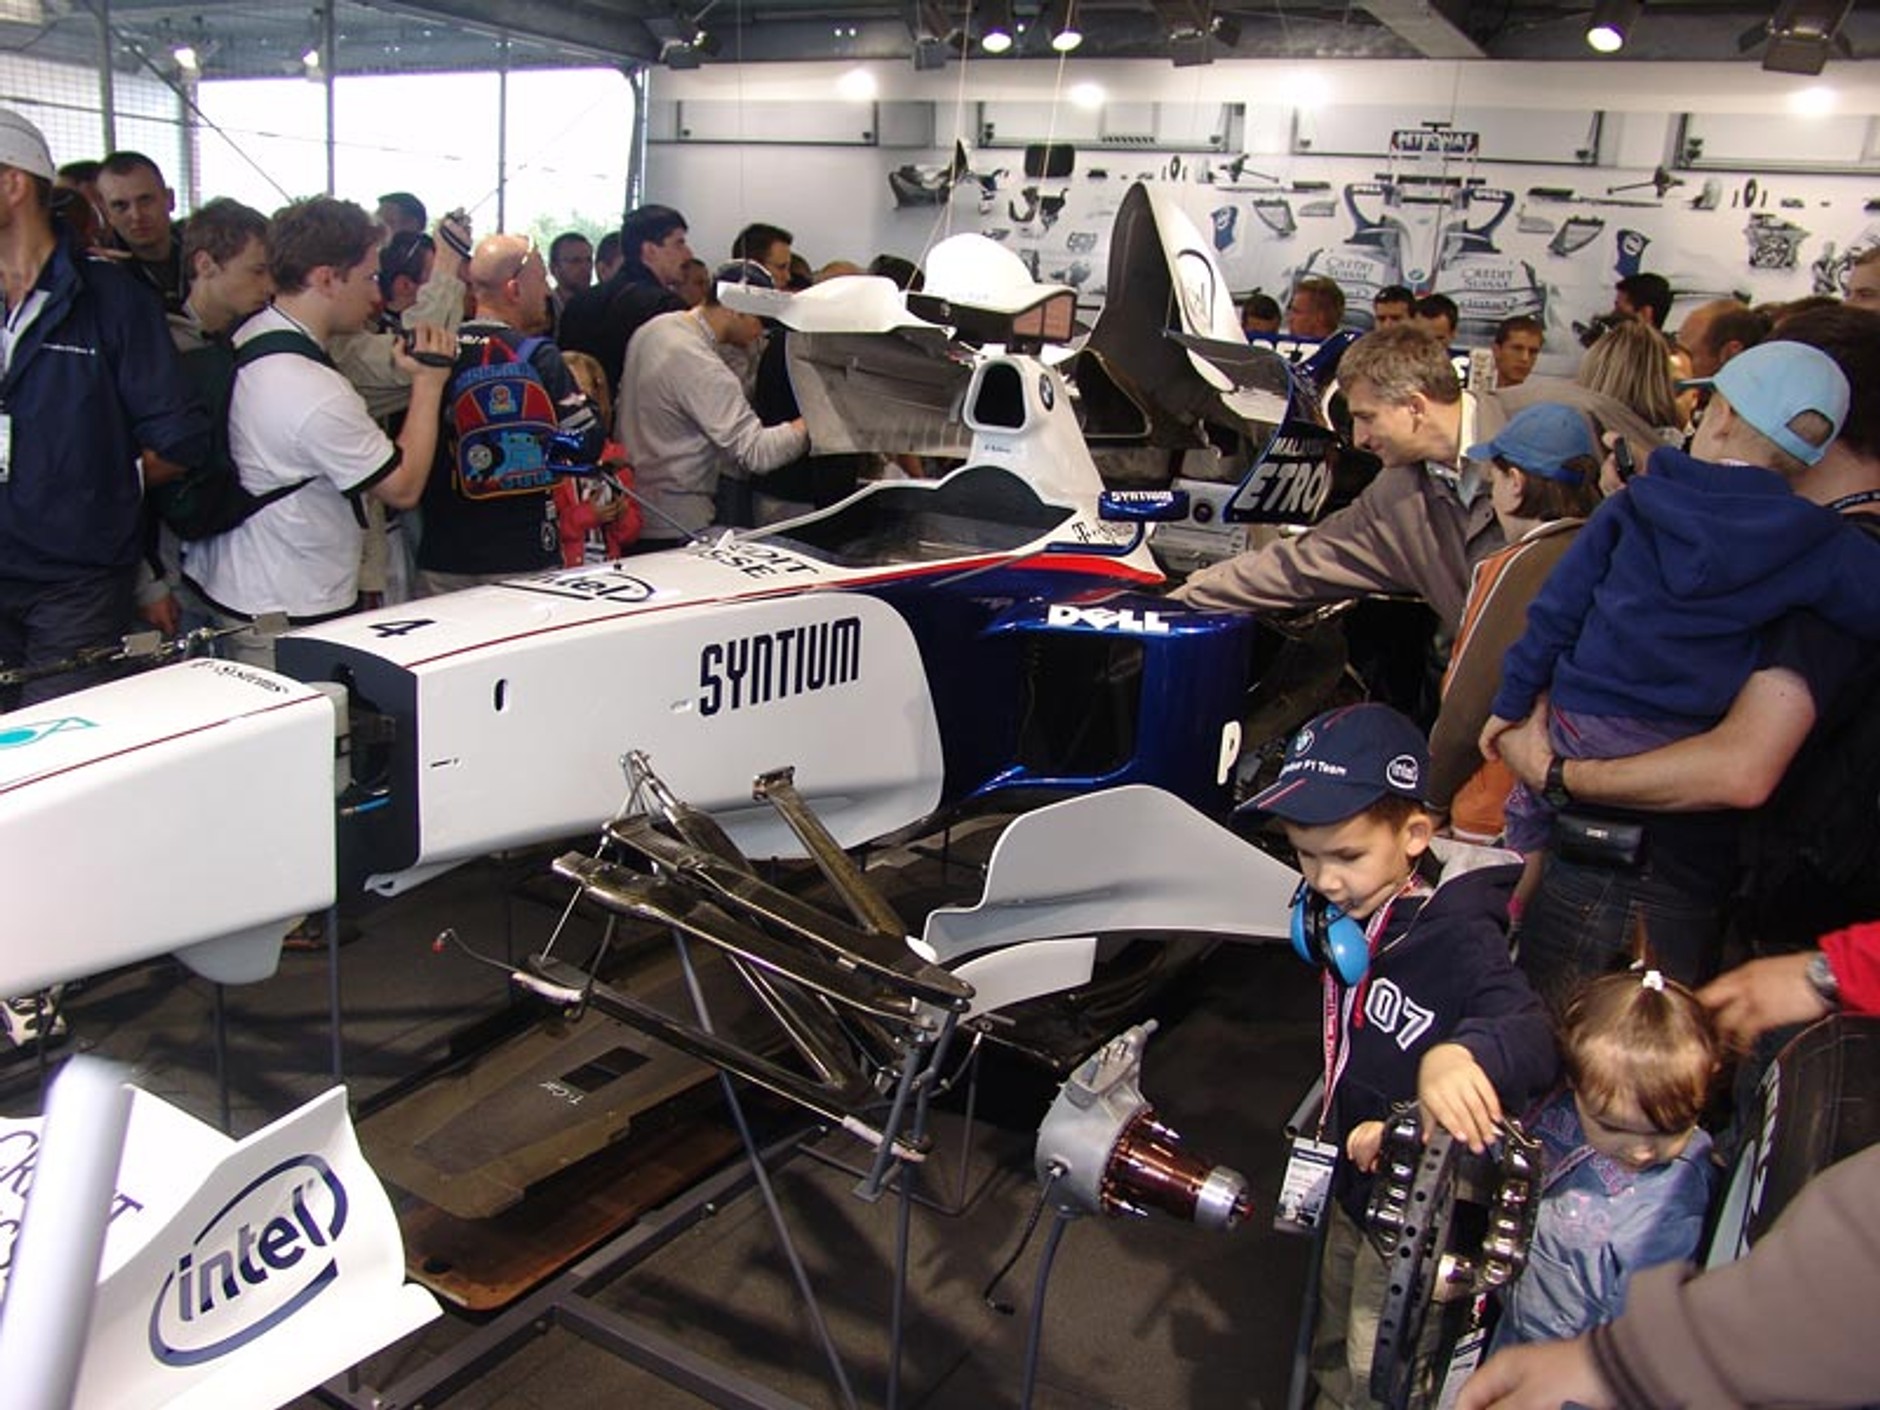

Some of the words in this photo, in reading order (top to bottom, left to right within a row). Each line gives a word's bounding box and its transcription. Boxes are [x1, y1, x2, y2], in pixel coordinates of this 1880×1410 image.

[1233, 461, 1333, 514] ETRO
[367, 618, 437, 638] 4
[1048, 604, 1170, 633] DELL
[699, 615, 861, 717] SYNTIUM
[1318, 761, 1348, 776] Team
[1364, 977, 1435, 1052] 07
[178, 1183, 328, 1322] intel
